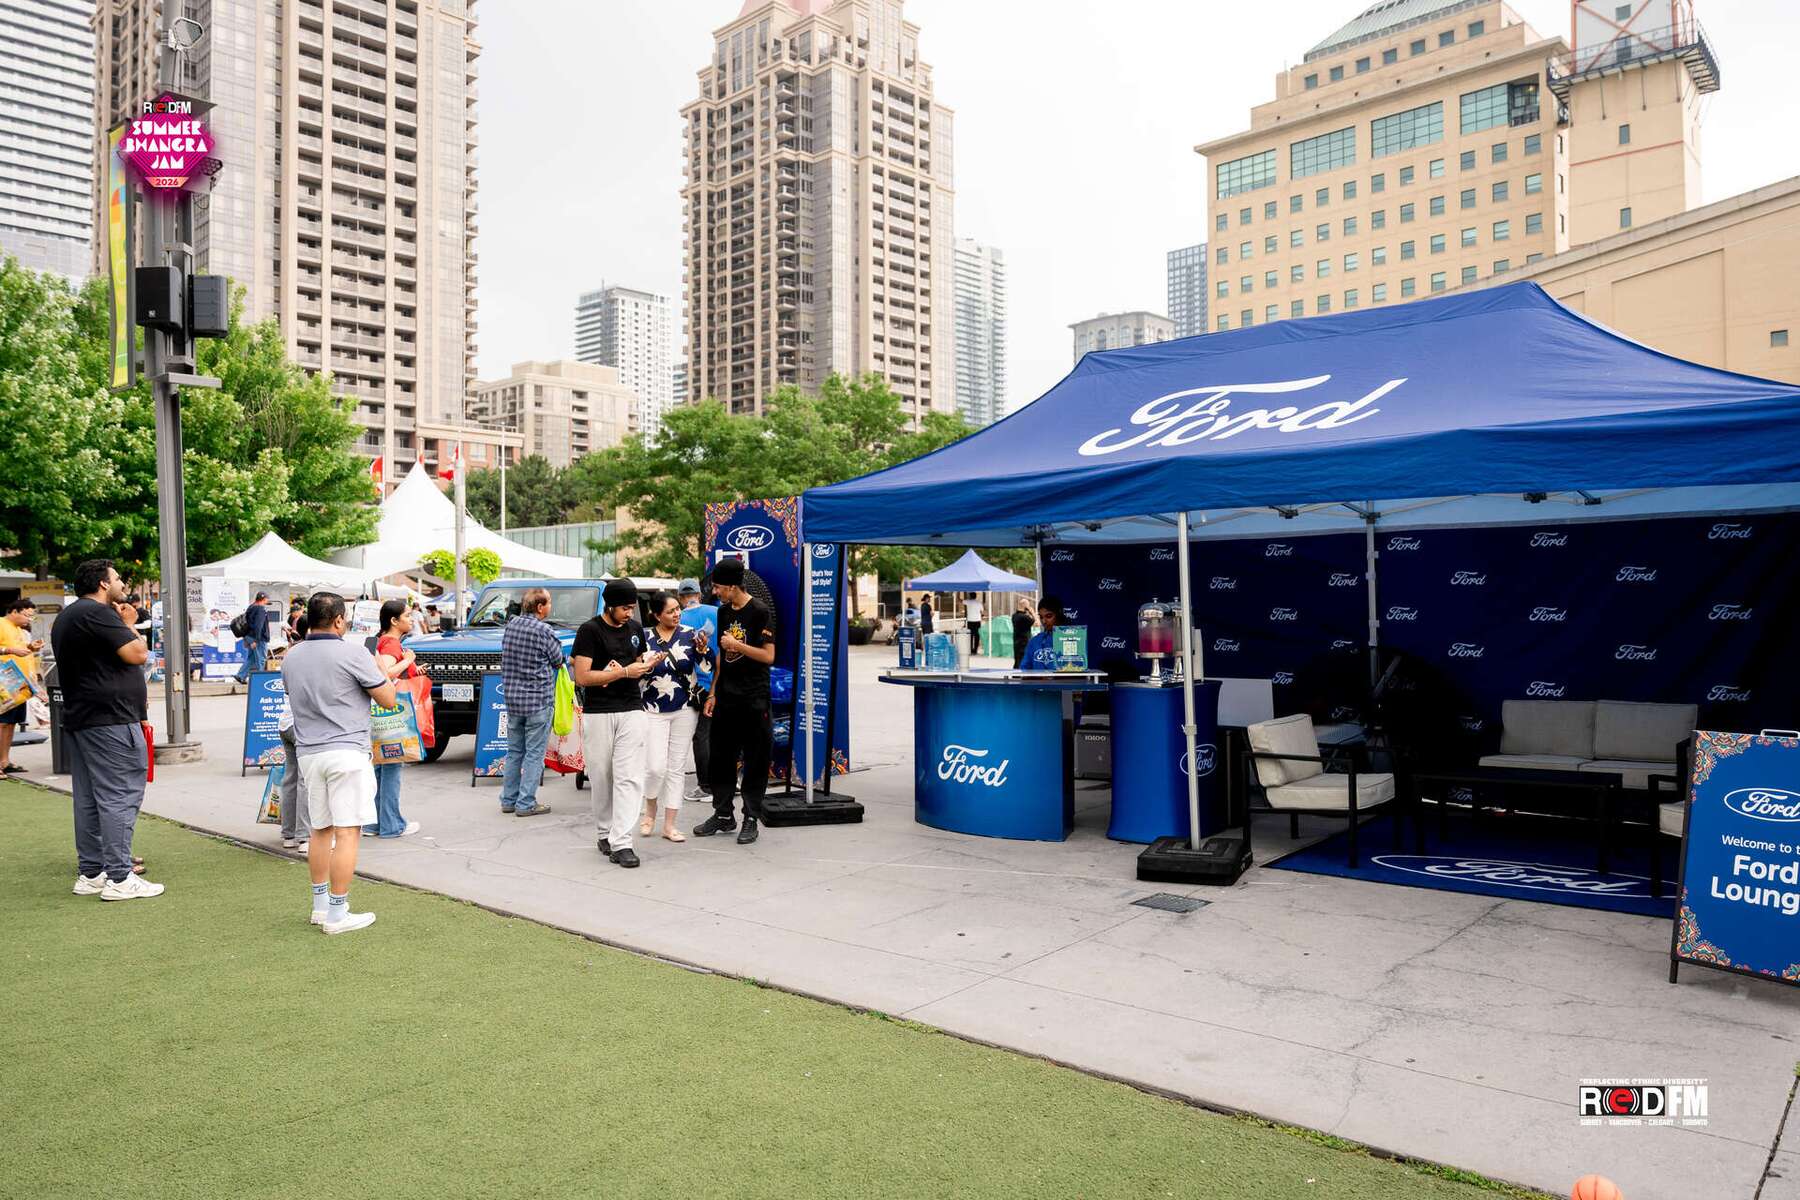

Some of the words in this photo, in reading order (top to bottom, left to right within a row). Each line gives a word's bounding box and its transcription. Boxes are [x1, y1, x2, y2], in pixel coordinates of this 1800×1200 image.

[1078, 374, 1408, 456] Ford
[735, 529, 765, 547] Ford
[1529, 532, 1567, 547] Ford
[1708, 524, 1752, 540] Ford
[815, 543, 830, 556] Ford
[1265, 543, 1292, 556] Ford
[1387, 537, 1421, 551] Ford
[1050, 550, 1074, 561] Ford
[1149, 548, 1174, 561] Ford
[1328, 573, 1358, 586] Ford
[1450, 571, 1486, 585] Ford
[1616, 566, 1656, 581] Ford
[1098, 578, 1123, 590] Ford
[1209, 577, 1236, 590] Ford
[1270, 607, 1298, 620] Ford
[1386, 606, 1418, 620] Ford
[1529, 606, 1567, 621] Ford
[1708, 604, 1752, 620] Ford
[1101, 637, 1127, 649] Ford
[1213, 638, 1240, 651] Ford
[1447, 643, 1485, 657] Ford
[1615, 645, 1656, 660] Ford
[1526, 681, 1564, 697] Ford
[1707, 685, 1751, 701] Ford
[938, 744, 1009, 787] Ford
[1741, 791, 1800, 818] Ford
[1721, 834, 1776, 851] Welcome
[1779, 842, 1792, 854] to
[1425, 861, 1640, 892] Ford
[1733, 854, 1799, 885] Ford
